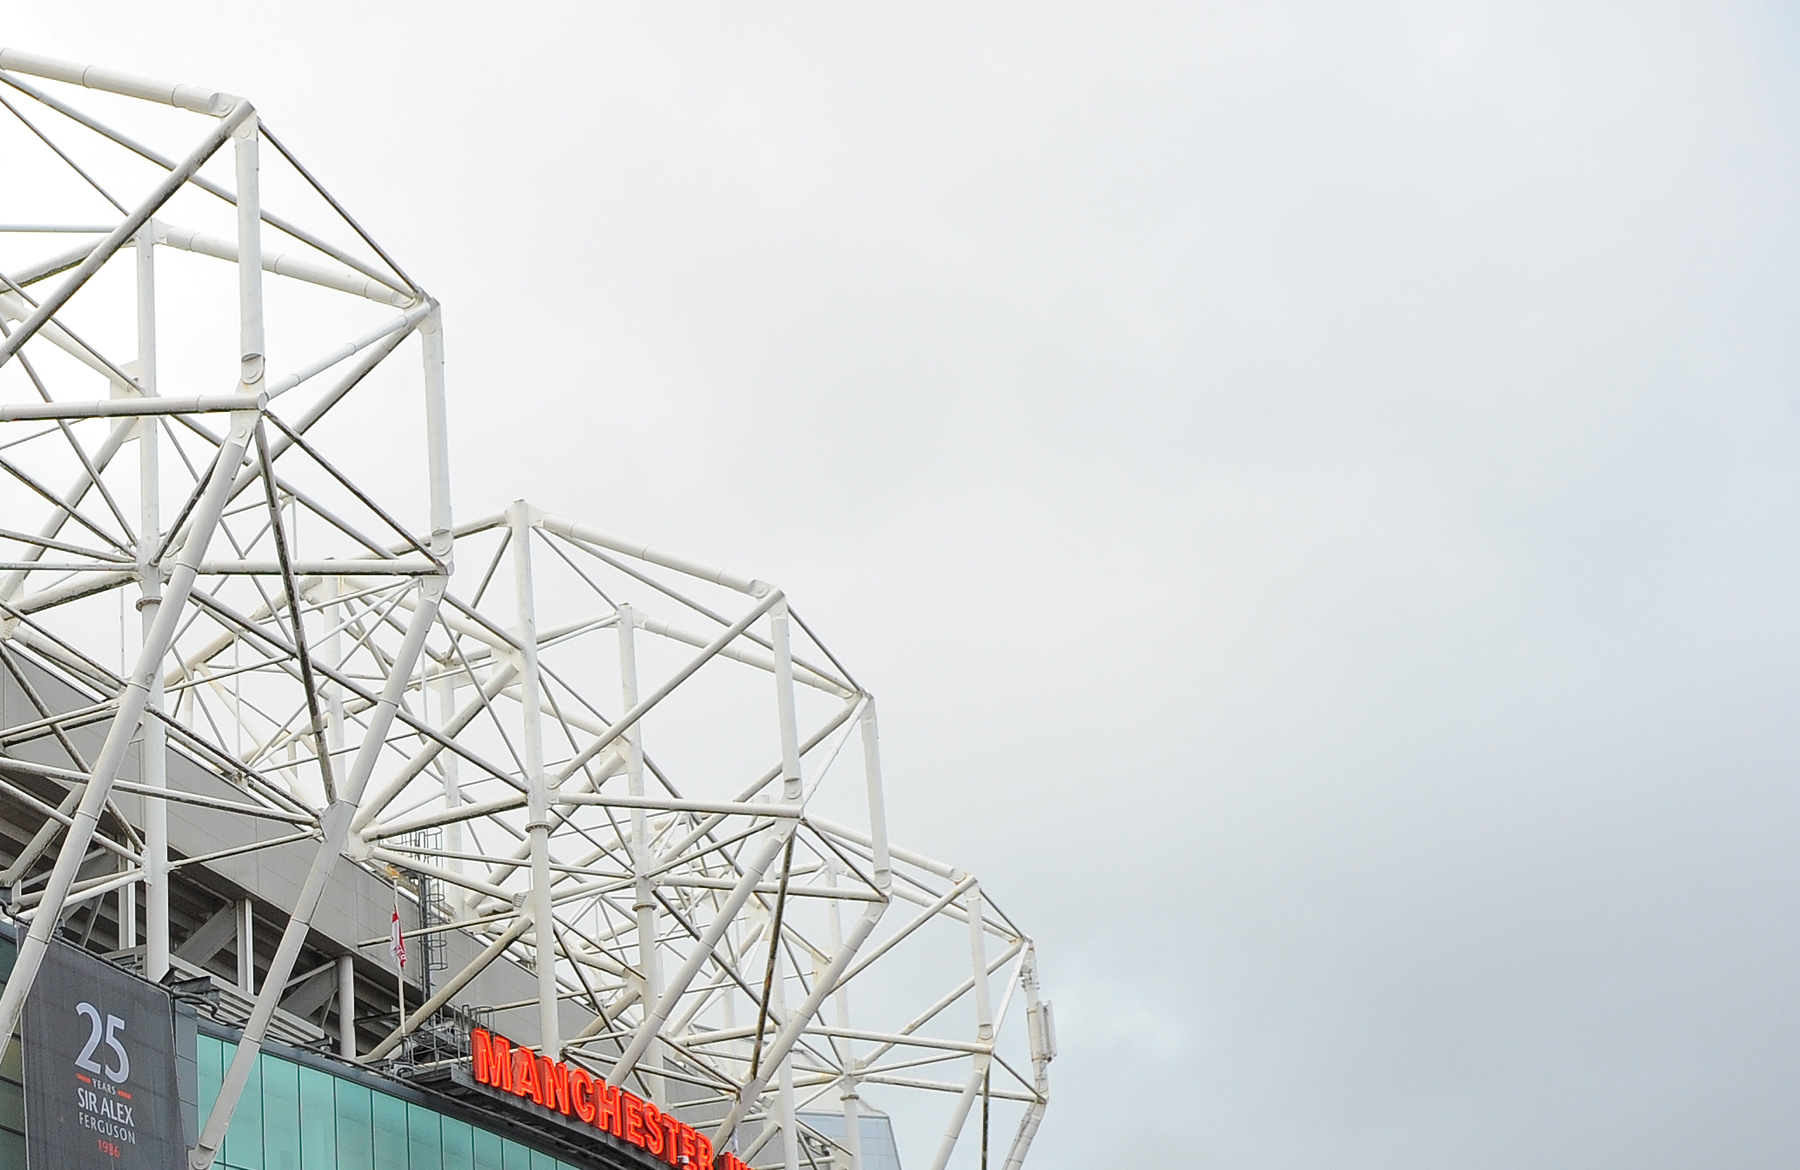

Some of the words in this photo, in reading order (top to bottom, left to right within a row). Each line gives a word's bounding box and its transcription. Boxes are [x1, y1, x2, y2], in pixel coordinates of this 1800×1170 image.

[75, 1002, 130, 1084] 25
[91, 1077, 116, 1096] YEARS
[77, 1086, 99, 1114] SIR
[100, 1097, 135, 1128] ALEX
[78, 1111, 136, 1145] FERGUSON
[97, 1139, 120, 1159] 1986
